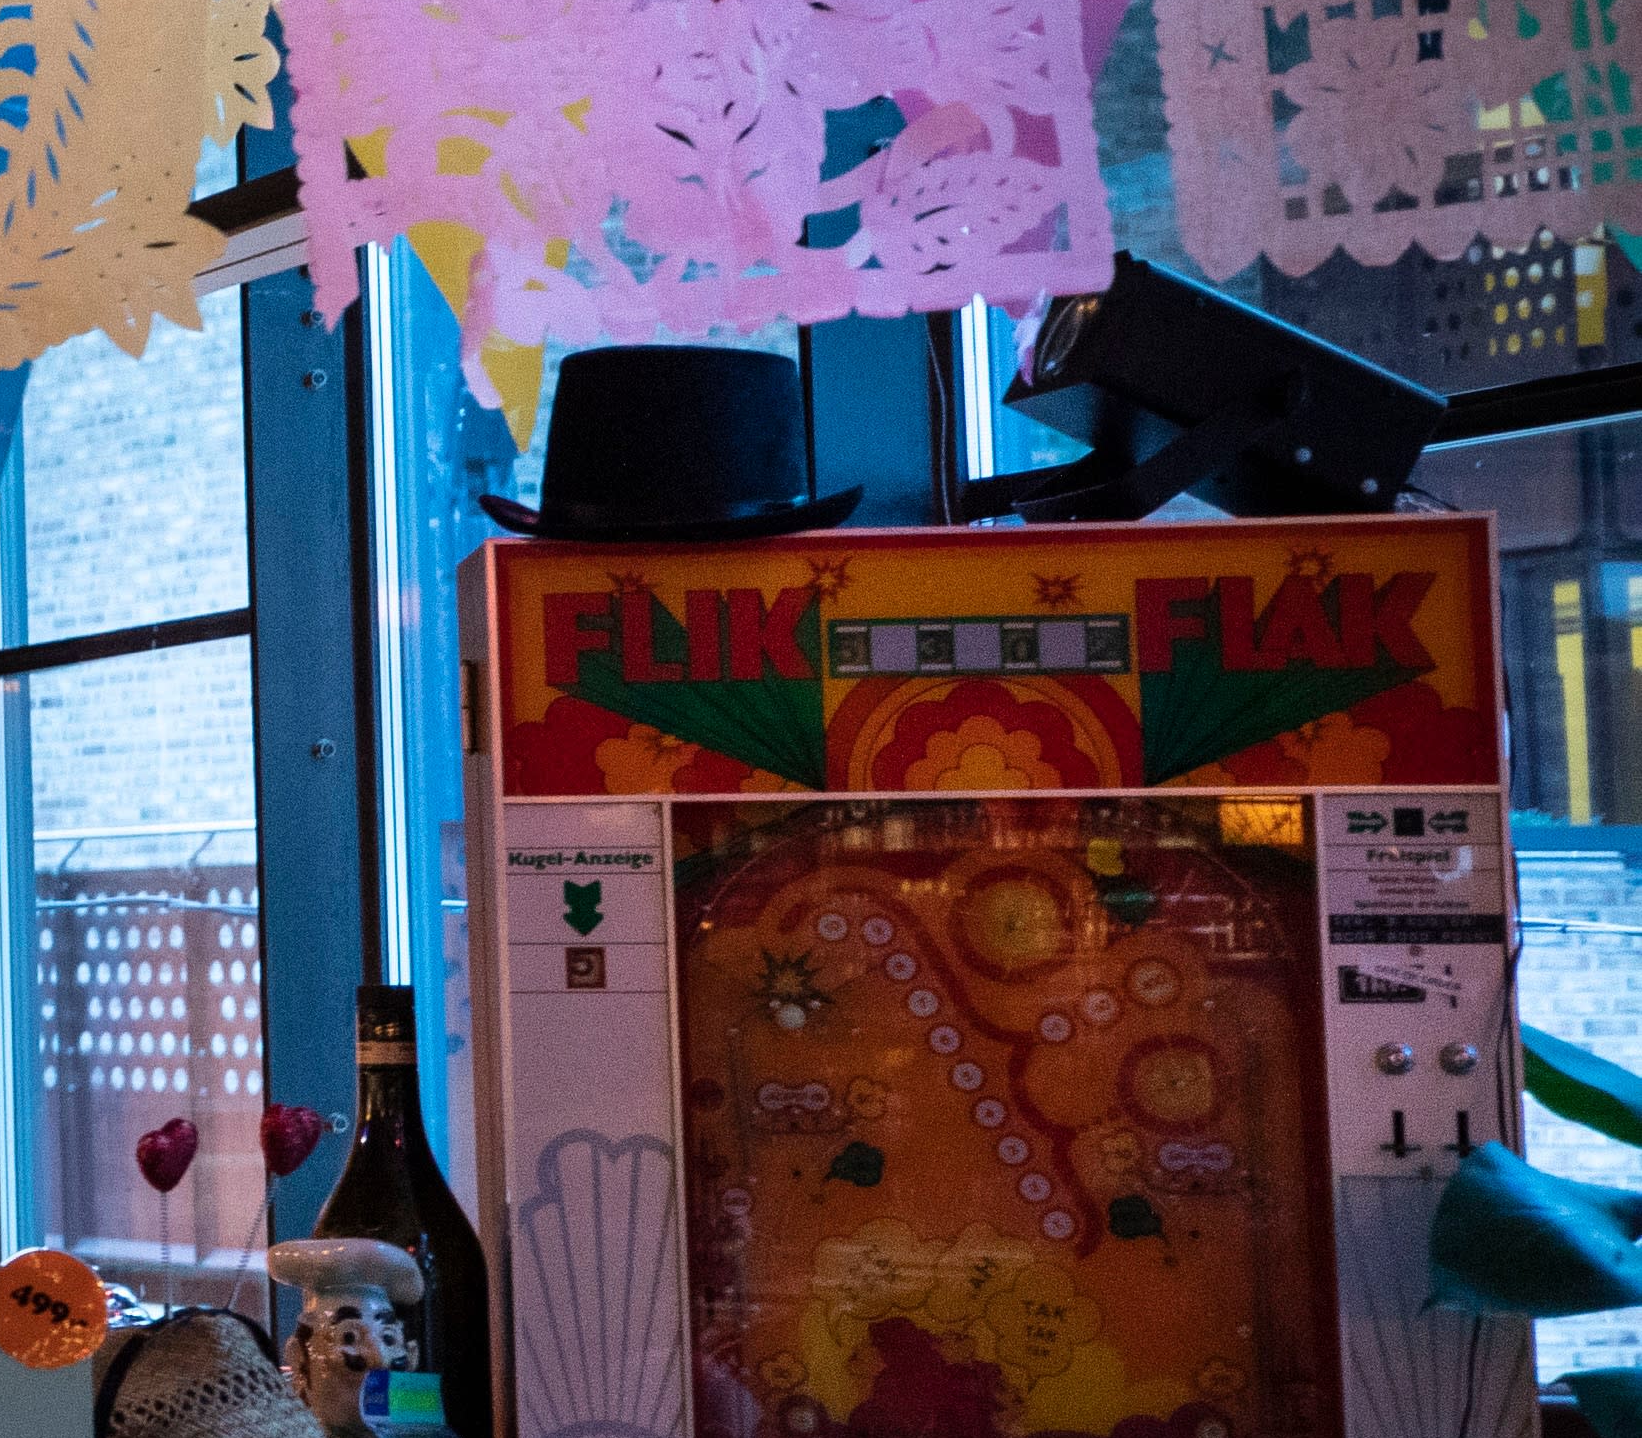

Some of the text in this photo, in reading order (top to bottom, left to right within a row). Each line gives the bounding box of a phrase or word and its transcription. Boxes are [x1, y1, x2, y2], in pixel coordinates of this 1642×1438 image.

[542, 573, 1437, 686] FLIK FLAK
[508, 850, 654, 870] Kugel-Anzeige
